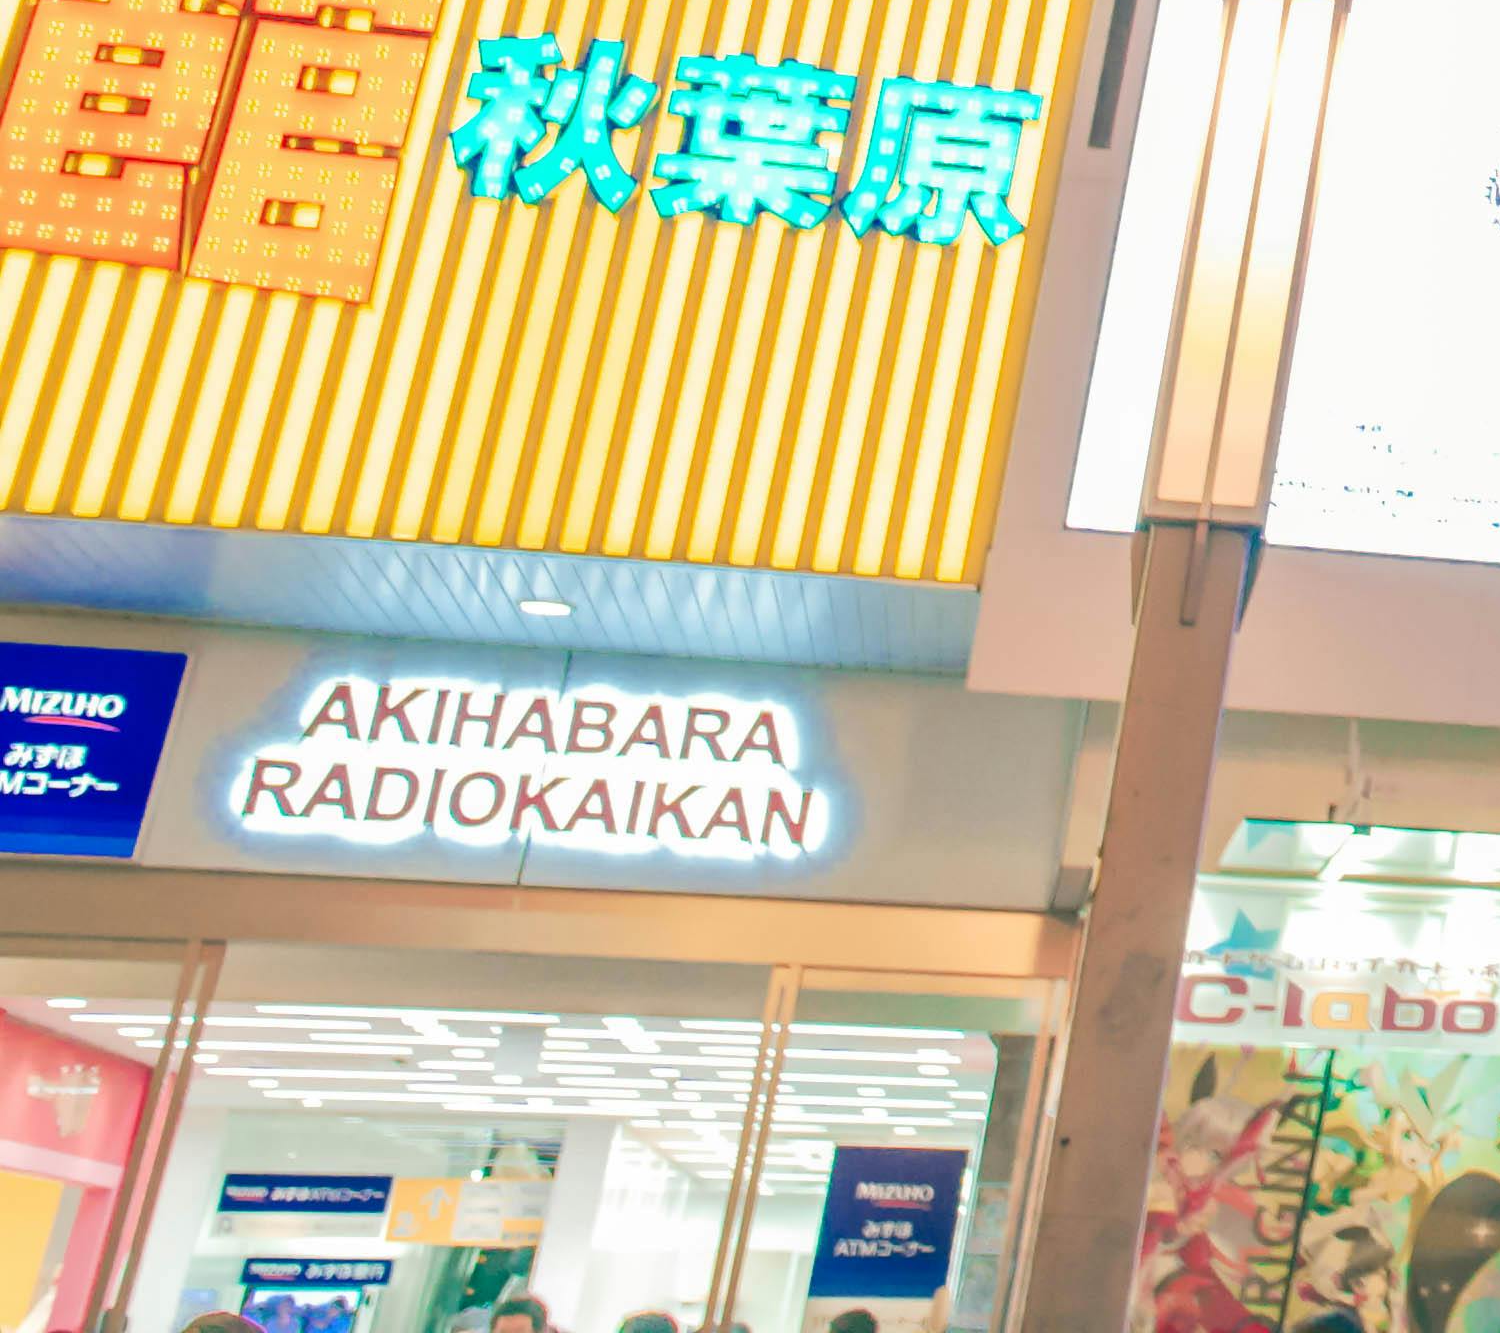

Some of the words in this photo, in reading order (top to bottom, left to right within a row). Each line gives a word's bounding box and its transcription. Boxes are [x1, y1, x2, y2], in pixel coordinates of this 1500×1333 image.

[449, 32, 1044, 248] 秋葉原
[0, 683, 127, 721] MIZUHO
[299, 678, 788, 771] AKIHABARA
[3, 742, 87, 774] みずほ
[241, 758, 813, 851] RADIOKAIKAN
[1174, 975, 1498, 1035] C-labo
